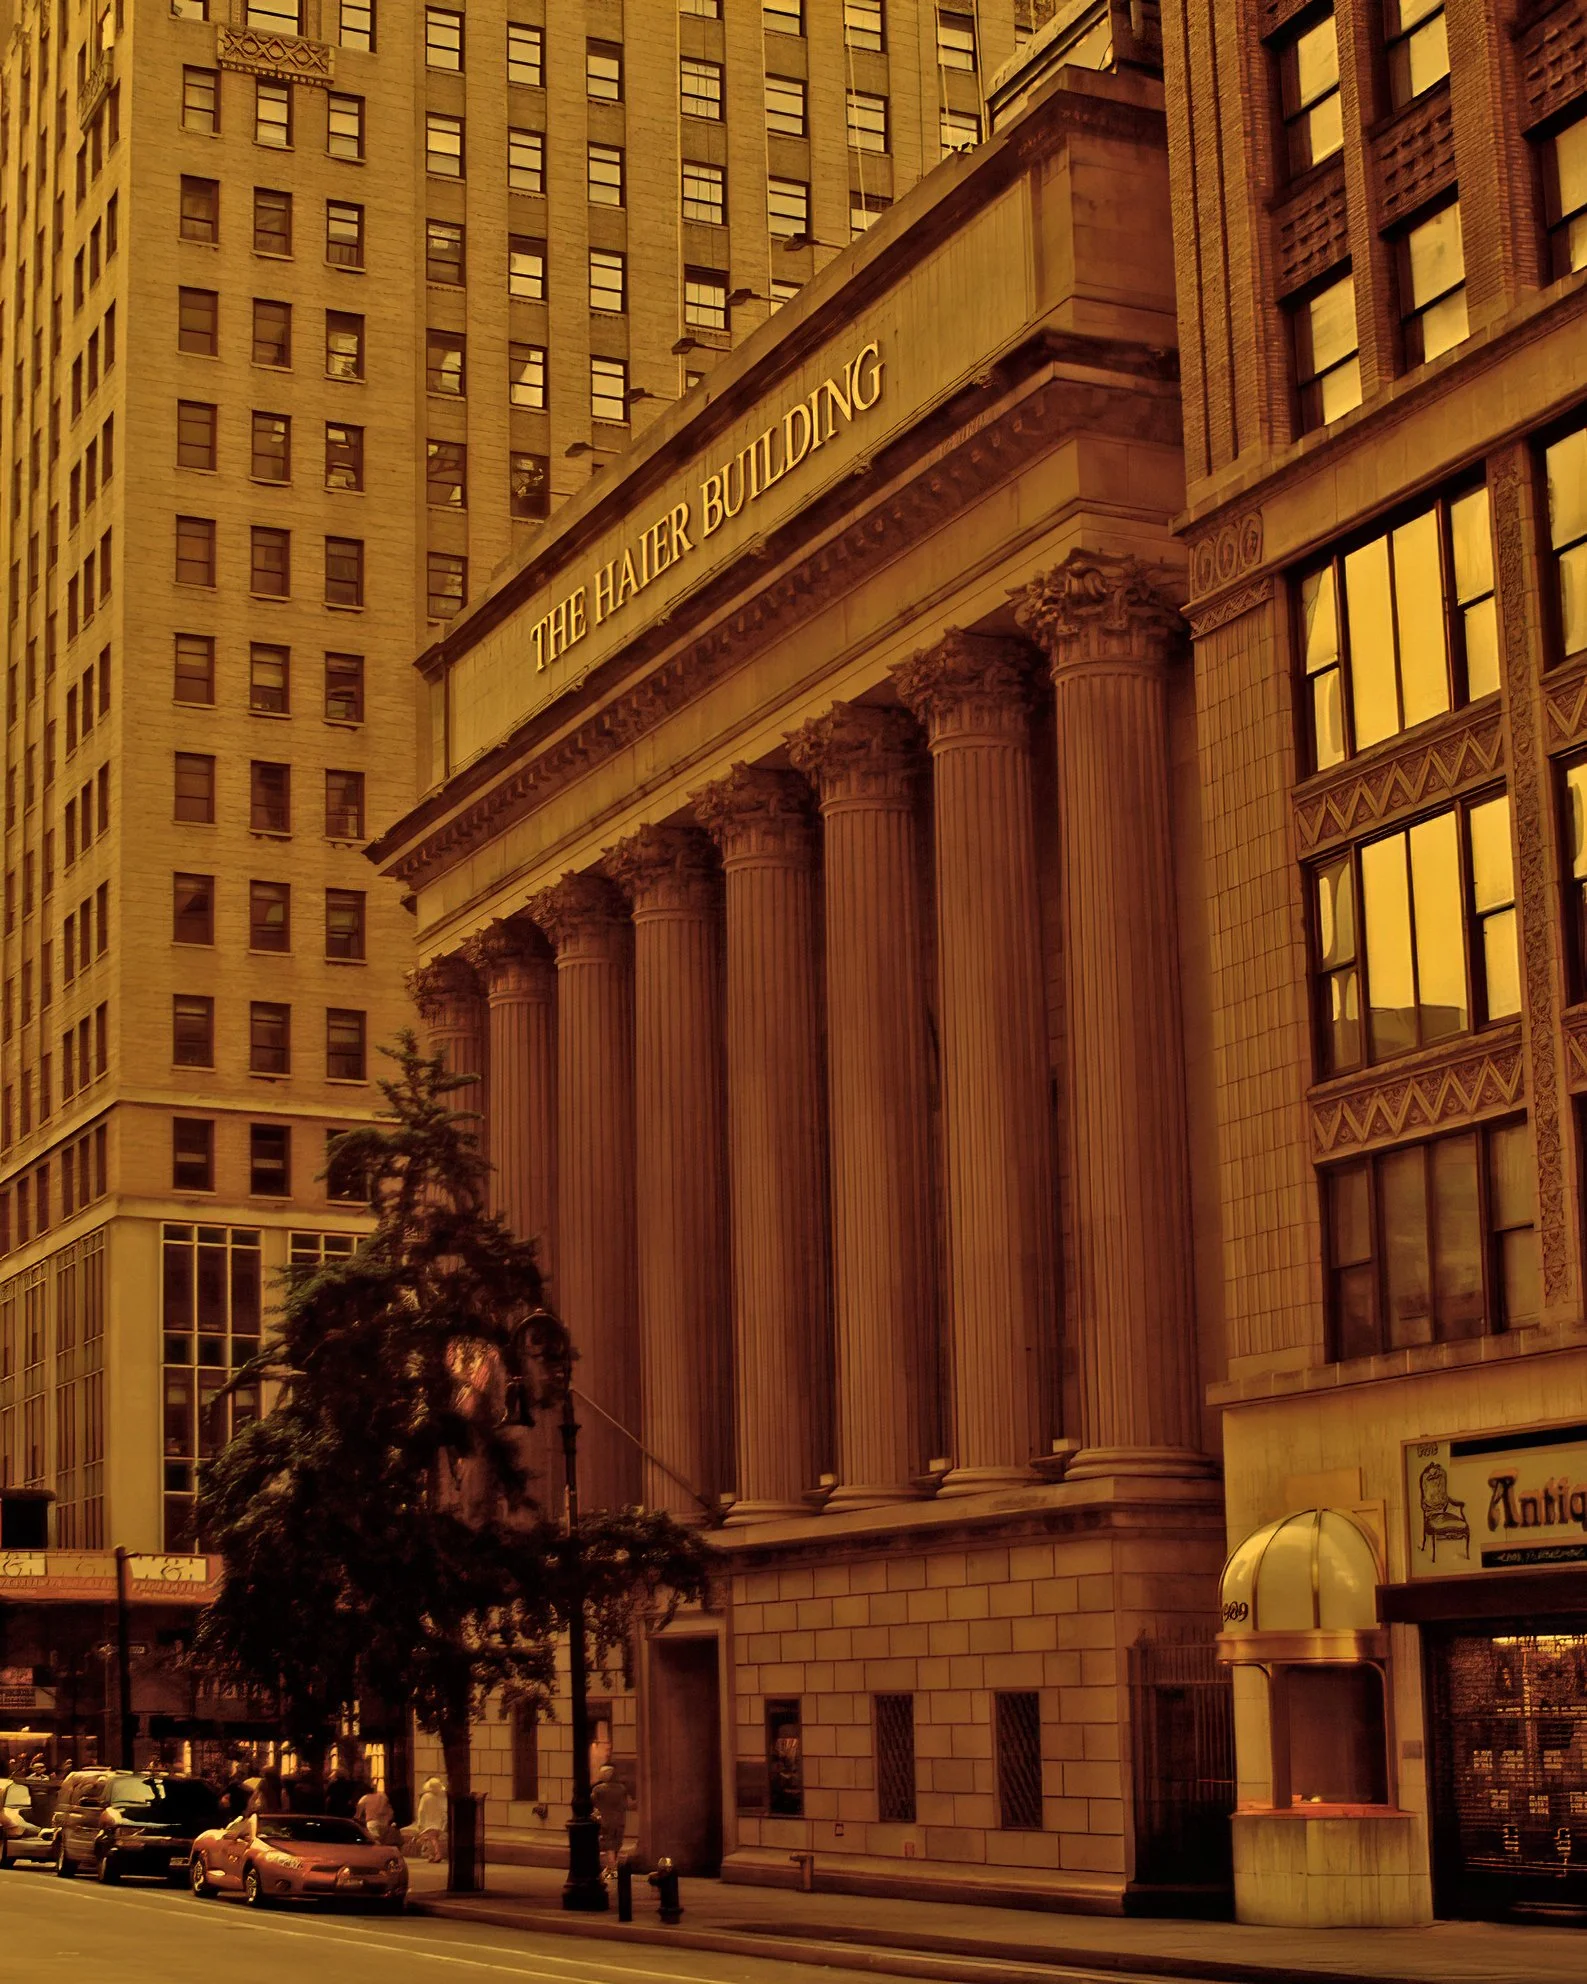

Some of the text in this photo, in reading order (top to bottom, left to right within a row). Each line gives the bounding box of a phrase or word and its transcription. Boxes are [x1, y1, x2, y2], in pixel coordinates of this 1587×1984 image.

[530, 339, 886, 674] THE HAIER BUILDING
